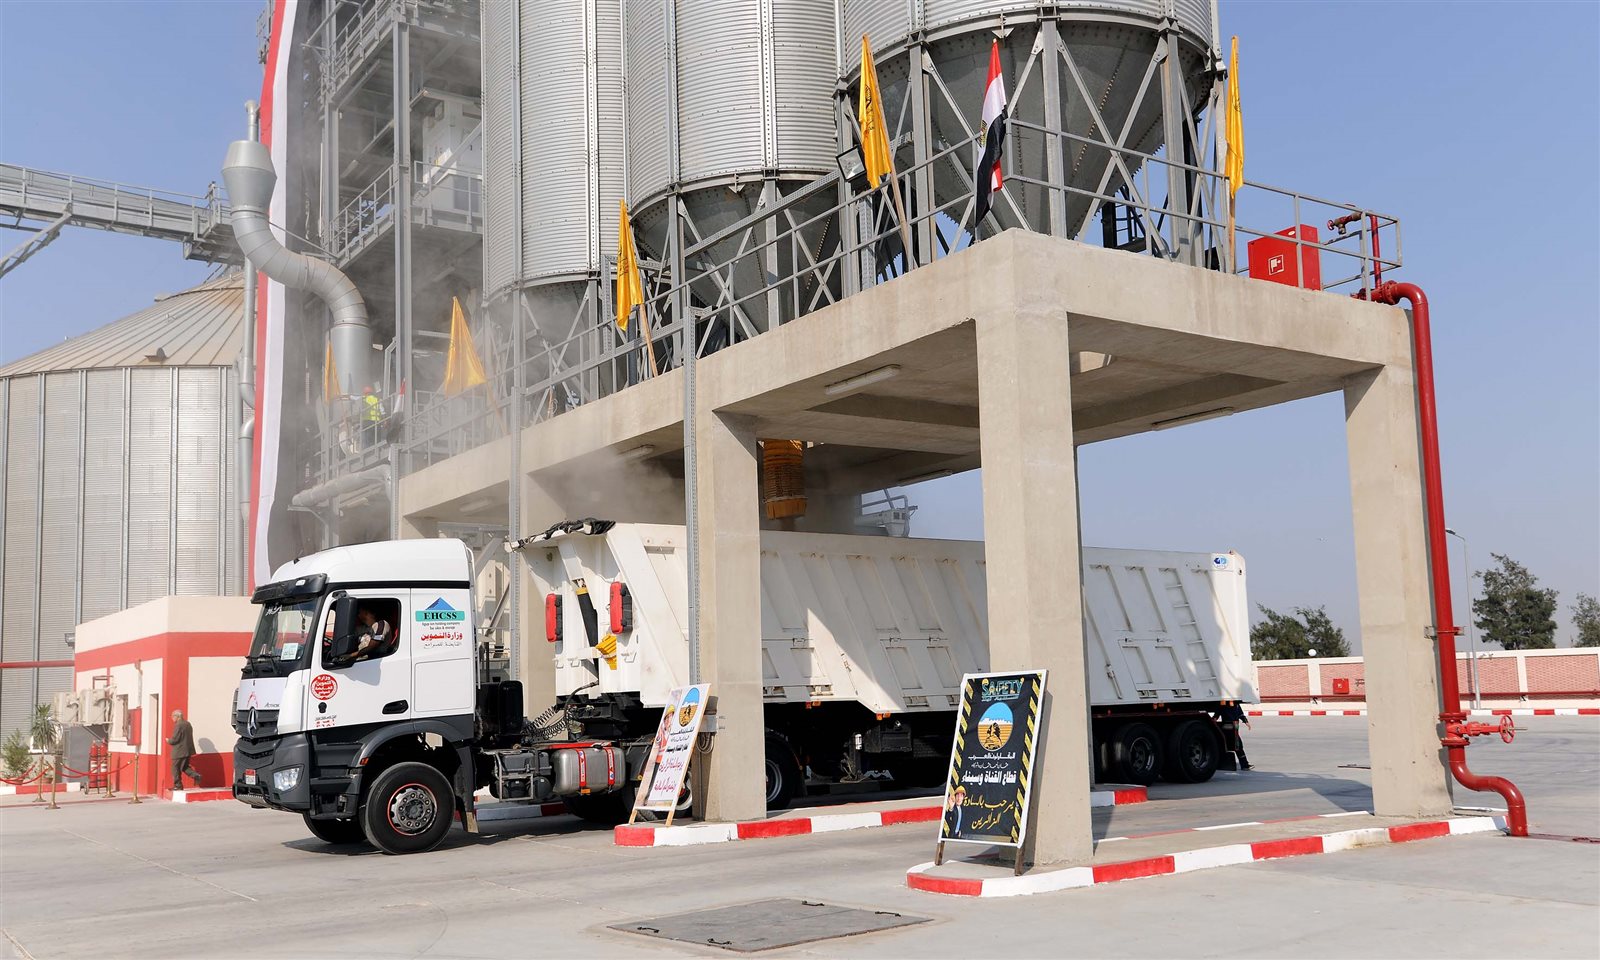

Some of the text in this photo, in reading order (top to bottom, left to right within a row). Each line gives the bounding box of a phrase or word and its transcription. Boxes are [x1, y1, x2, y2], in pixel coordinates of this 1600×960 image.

[424, 612, 457, 620] EHCSS
[421, 631, 463, 641] وزارة التموين
[981, 677, 1024, 696] SAFETY
[961, 770, 1017, 786] قطاع القناة وسيناء
[963, 794, 1014, 814] يرحب بالسادة
[971, 812, 1002, 830] الزائرين
